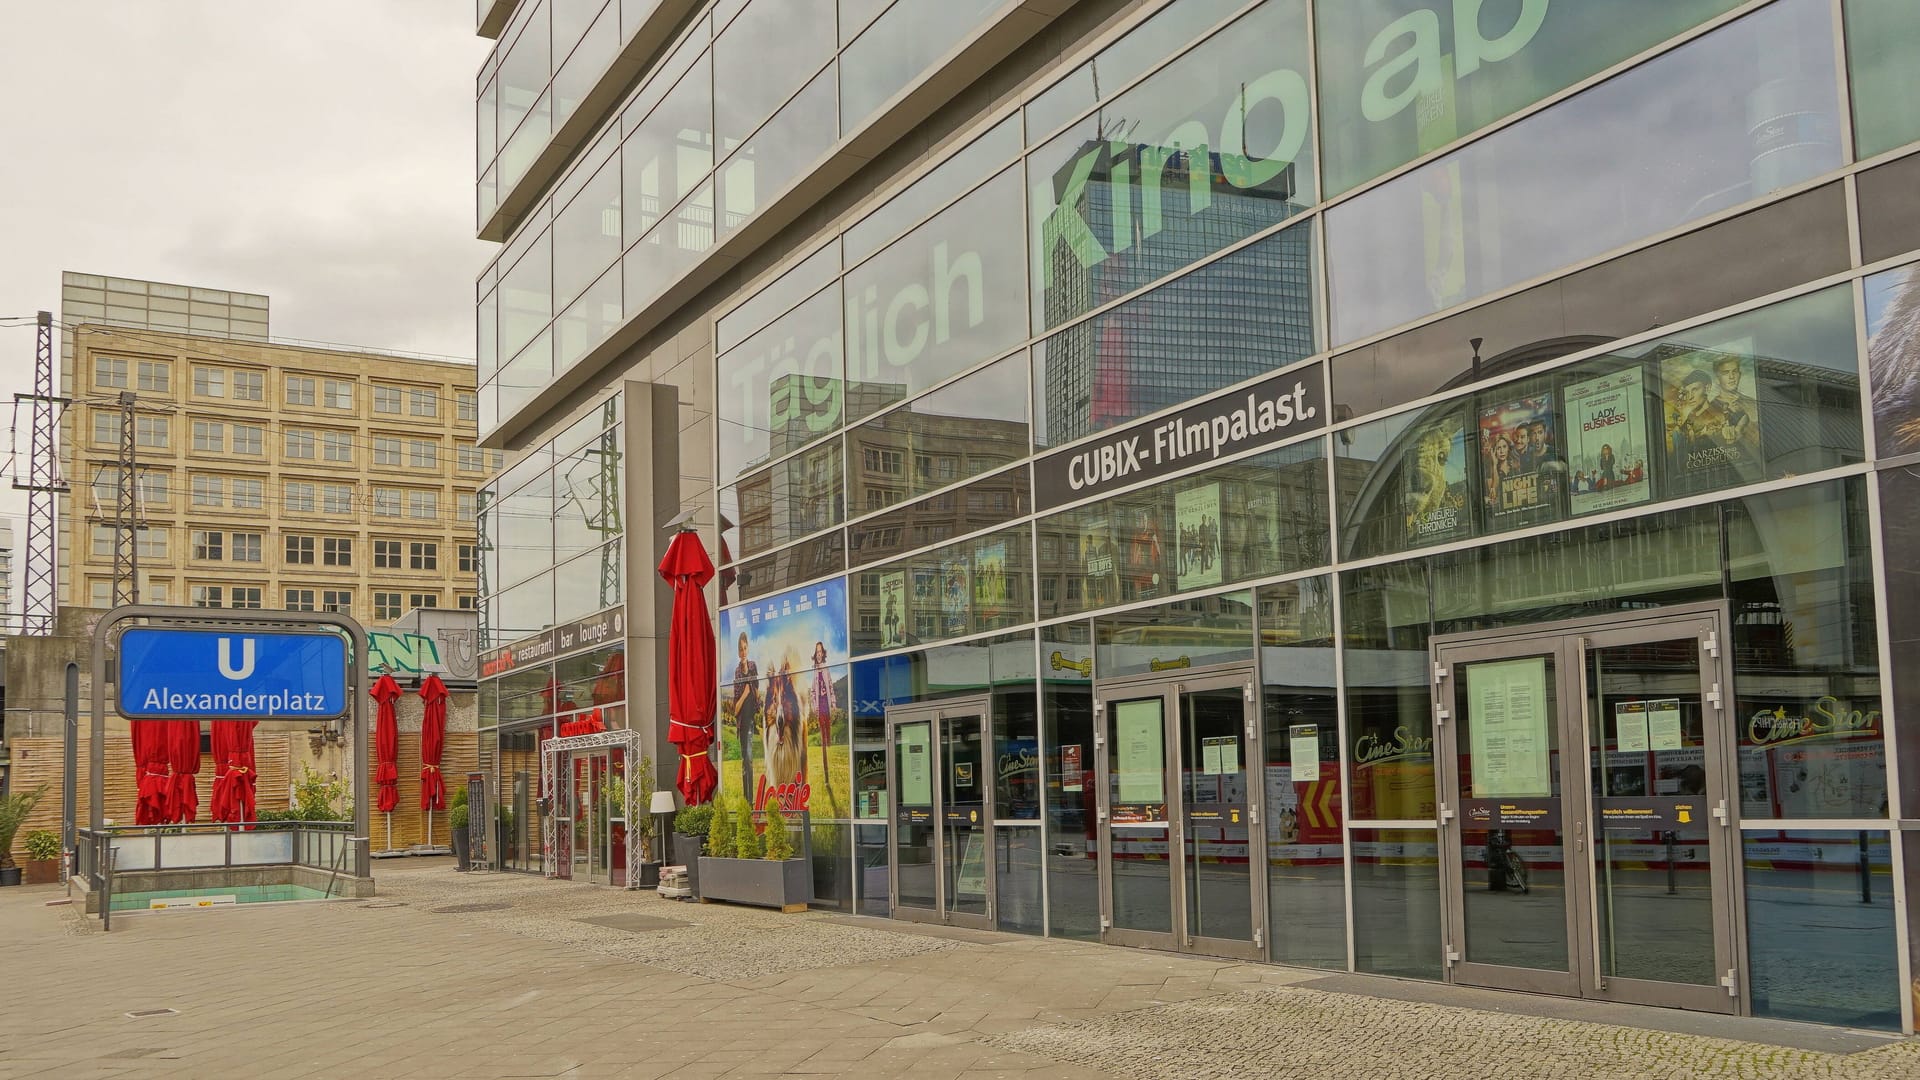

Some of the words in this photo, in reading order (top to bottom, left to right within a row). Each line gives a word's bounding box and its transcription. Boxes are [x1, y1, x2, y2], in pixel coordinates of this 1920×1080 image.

[1043, 69, 1310, 290] Kino
[1583, 413, 1626, 432] BUSINESS
[1591, 407, 1616, 421] LADY
[1068, 435, 1149, 490] CUBIX-
[1154, 381, 1316, 465] Filmpalast.
[1502, 474, 1539, 493] NIGHT
[1502, 486, 1538, 510] LIFE
[1418, 517, 1457, 534] CHRONIKEN
[518, 639, 552, 662] restaurant
[561, 631, 574, 649] bar
[580, 622, 608, 643] lounge
[218, 637, 255, 681] U
[143, 687, 325, 716] Alexanderplatz
[858, 754, 886, 777] CineSta
